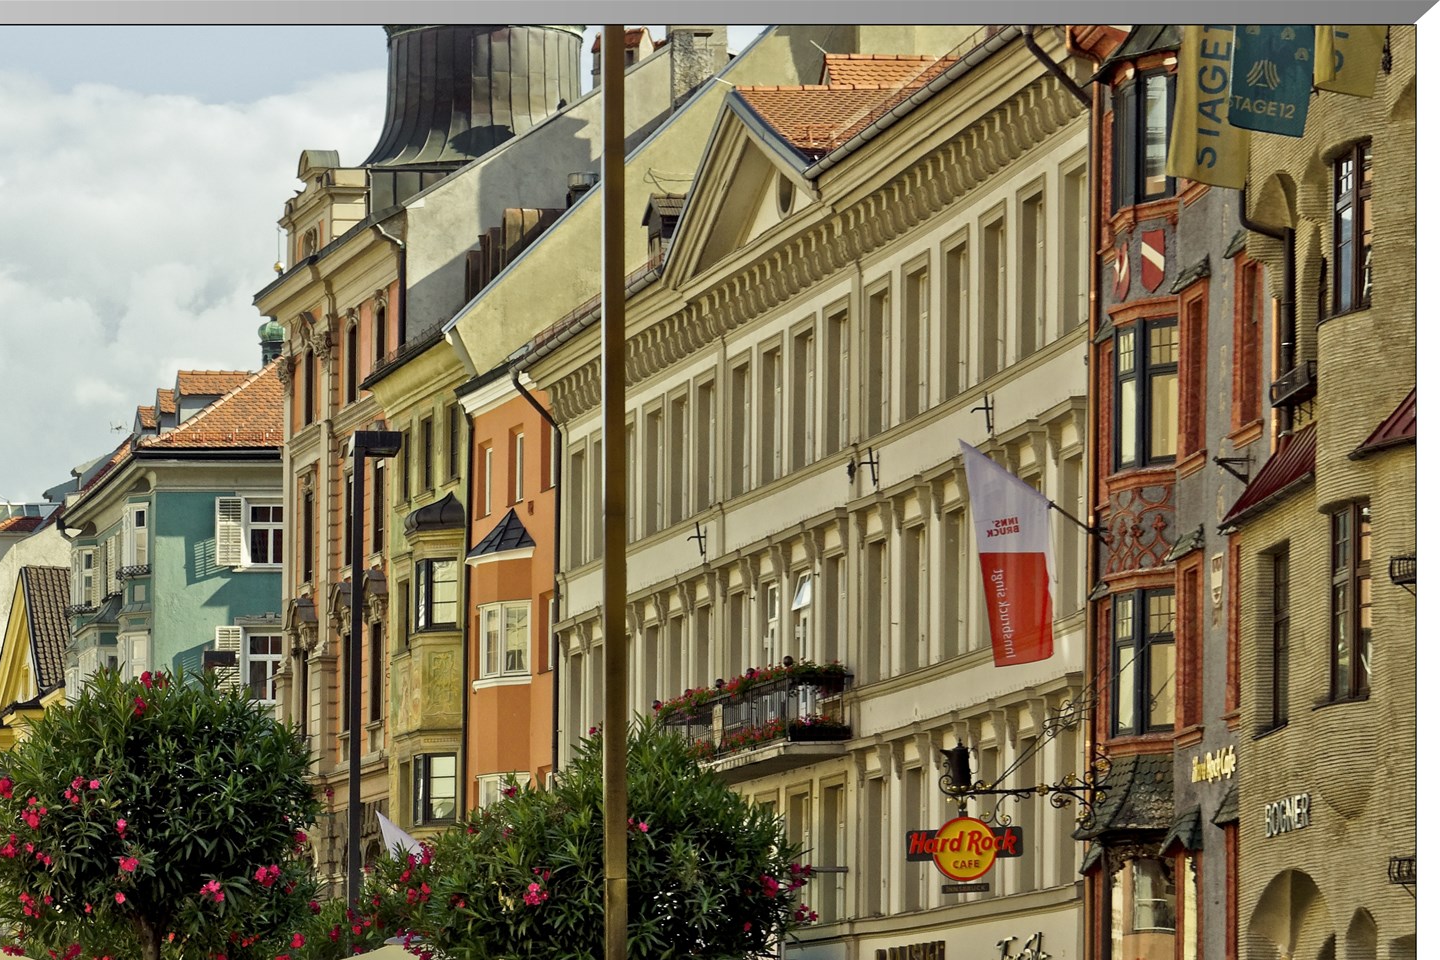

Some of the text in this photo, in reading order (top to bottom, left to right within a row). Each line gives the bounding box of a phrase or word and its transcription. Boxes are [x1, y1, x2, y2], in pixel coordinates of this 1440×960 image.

[1265, 793, 1310, 838] BOGNER
[909, 828, 1018, 855] Hard Rock
[952, 860, 980, 869] CAFE
